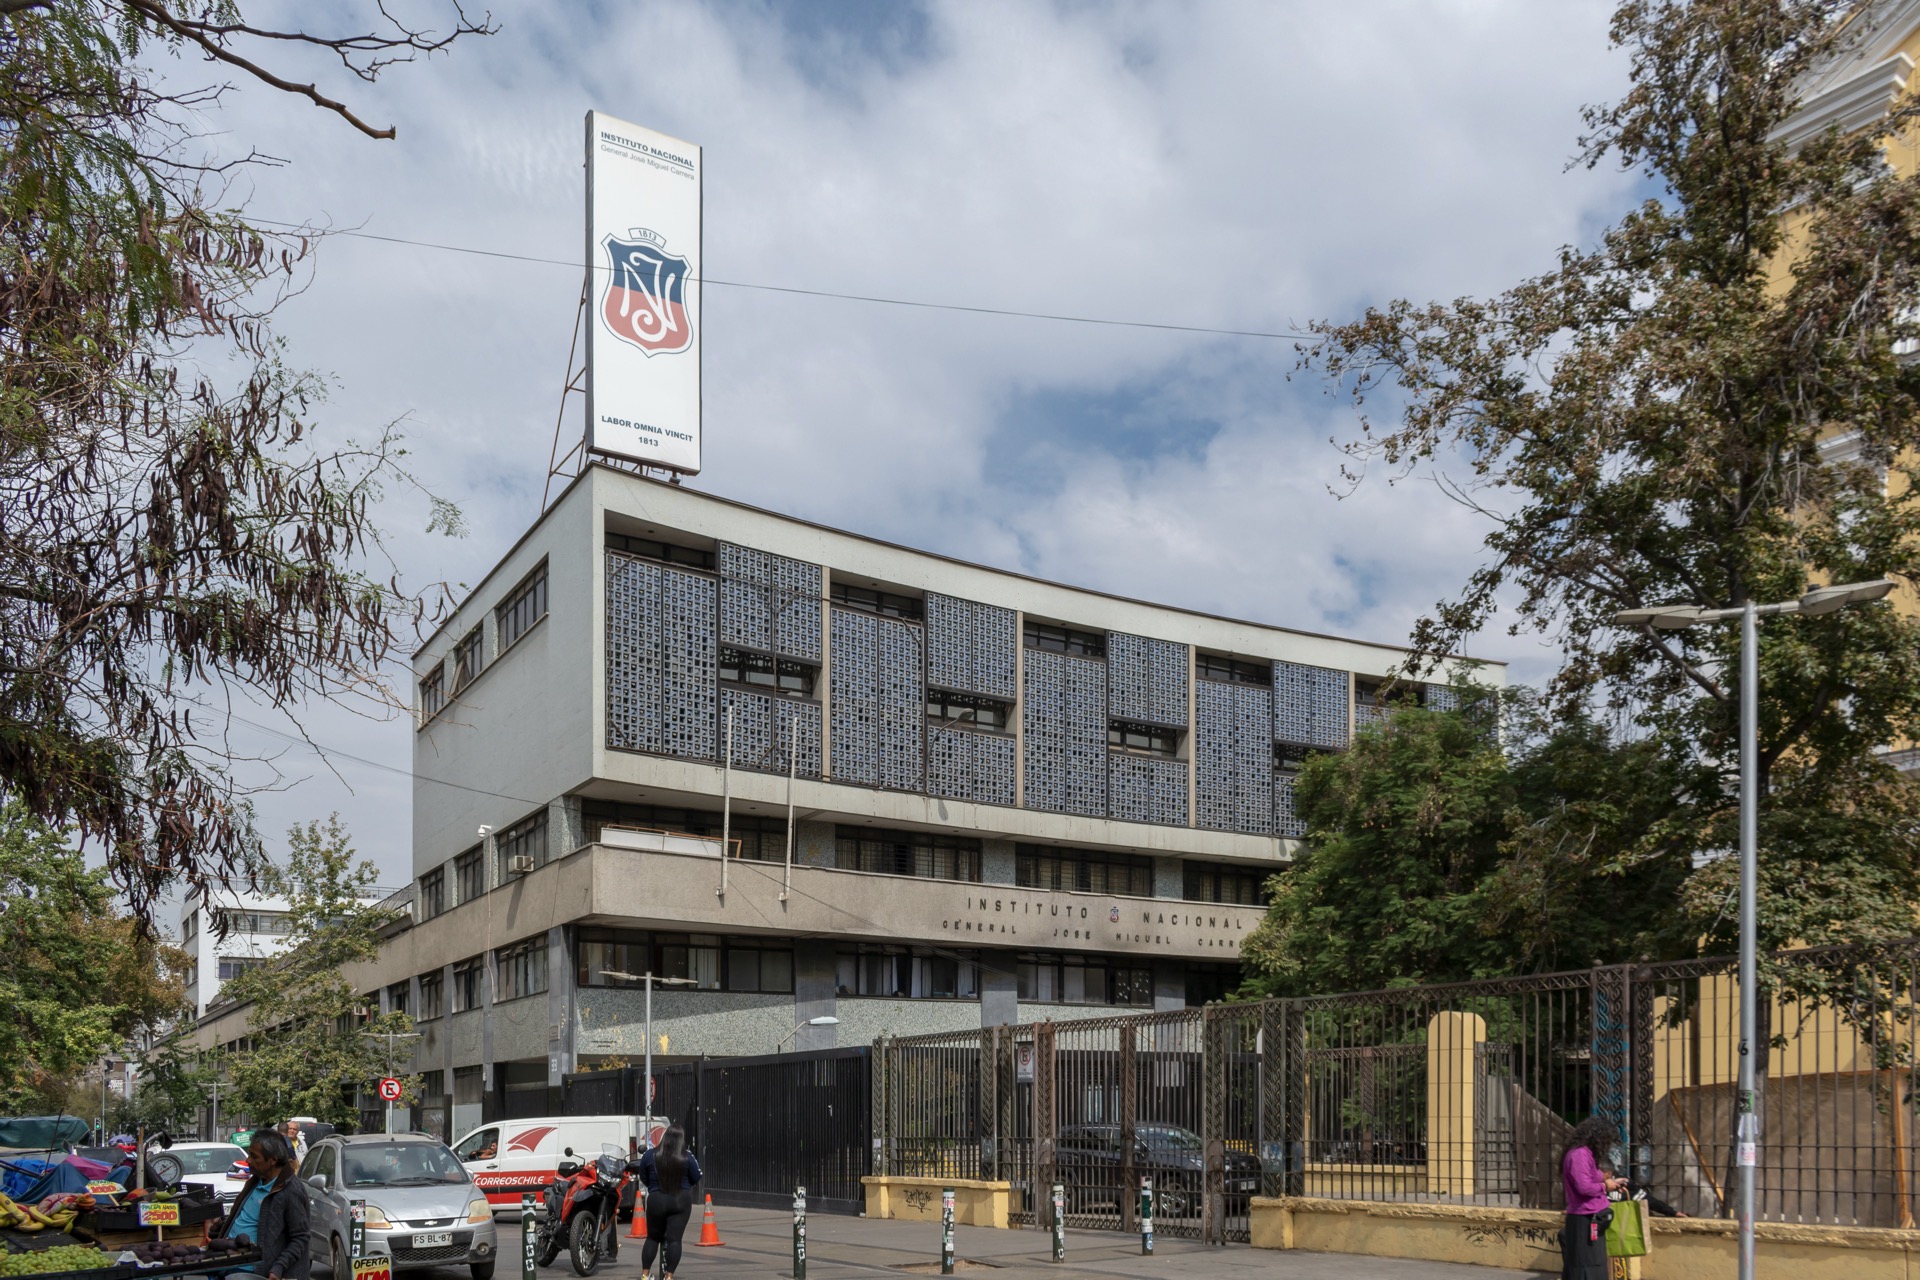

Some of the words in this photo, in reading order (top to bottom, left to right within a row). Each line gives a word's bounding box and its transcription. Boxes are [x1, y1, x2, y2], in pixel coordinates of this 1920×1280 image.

[600, 131, 648, 152] INSTITUTO
[650, 147, 694, 168] NACIONAL
[600, 144, 628, 158] General
[629, 153, 645, 164] José
[647, 158, 669, 172] Miguel
[670, 166, 695, 181] Carrera
[638, 229, 657, 241] 1813
[601, 415, 632, 428] LABOR
[633, 422, 663, 435] OMNIA
[664, 428, 693, 442] VINCIT
[638, 436, 659, 447] 1813
[967, 897, 1088, 919] INSTITUTO
[1143, 912, 1242, 930] NACIONAL
[1053, 928, 1091, 940] JOSE
[1197, 938, 1235, 949] CARR
[475, 1175, 545, 1186] CORREOSCHILE
[143, 1210, 178, 1222] 2500
[353, 1257, 390, 1270] OFERTA
